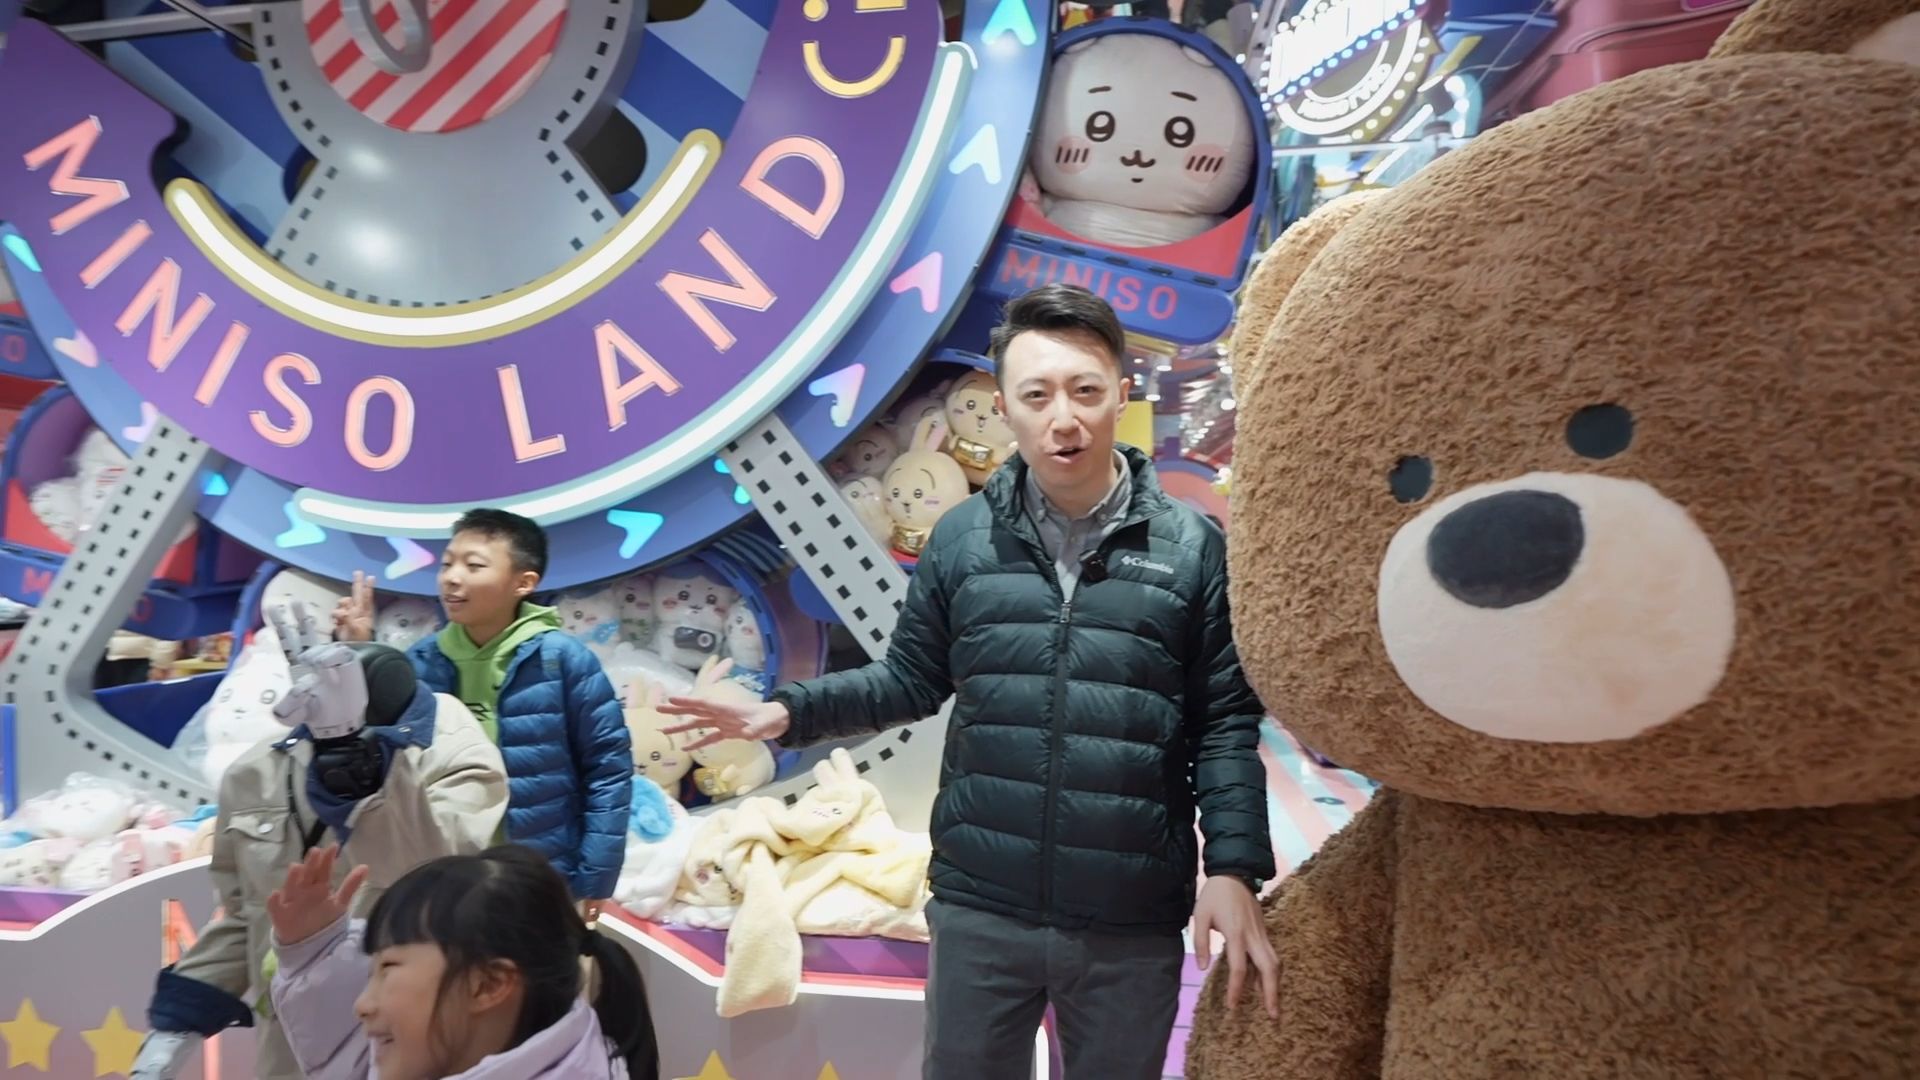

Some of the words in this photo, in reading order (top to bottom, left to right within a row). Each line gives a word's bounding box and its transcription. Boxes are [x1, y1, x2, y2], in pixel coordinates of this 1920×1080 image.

[23, 114, 416, 472] MINISO
[496, 134, 846, 462] LAND
[1001, 248, 1179, 320] MINISO
[1131, 556, 1175, 575] Columbia
